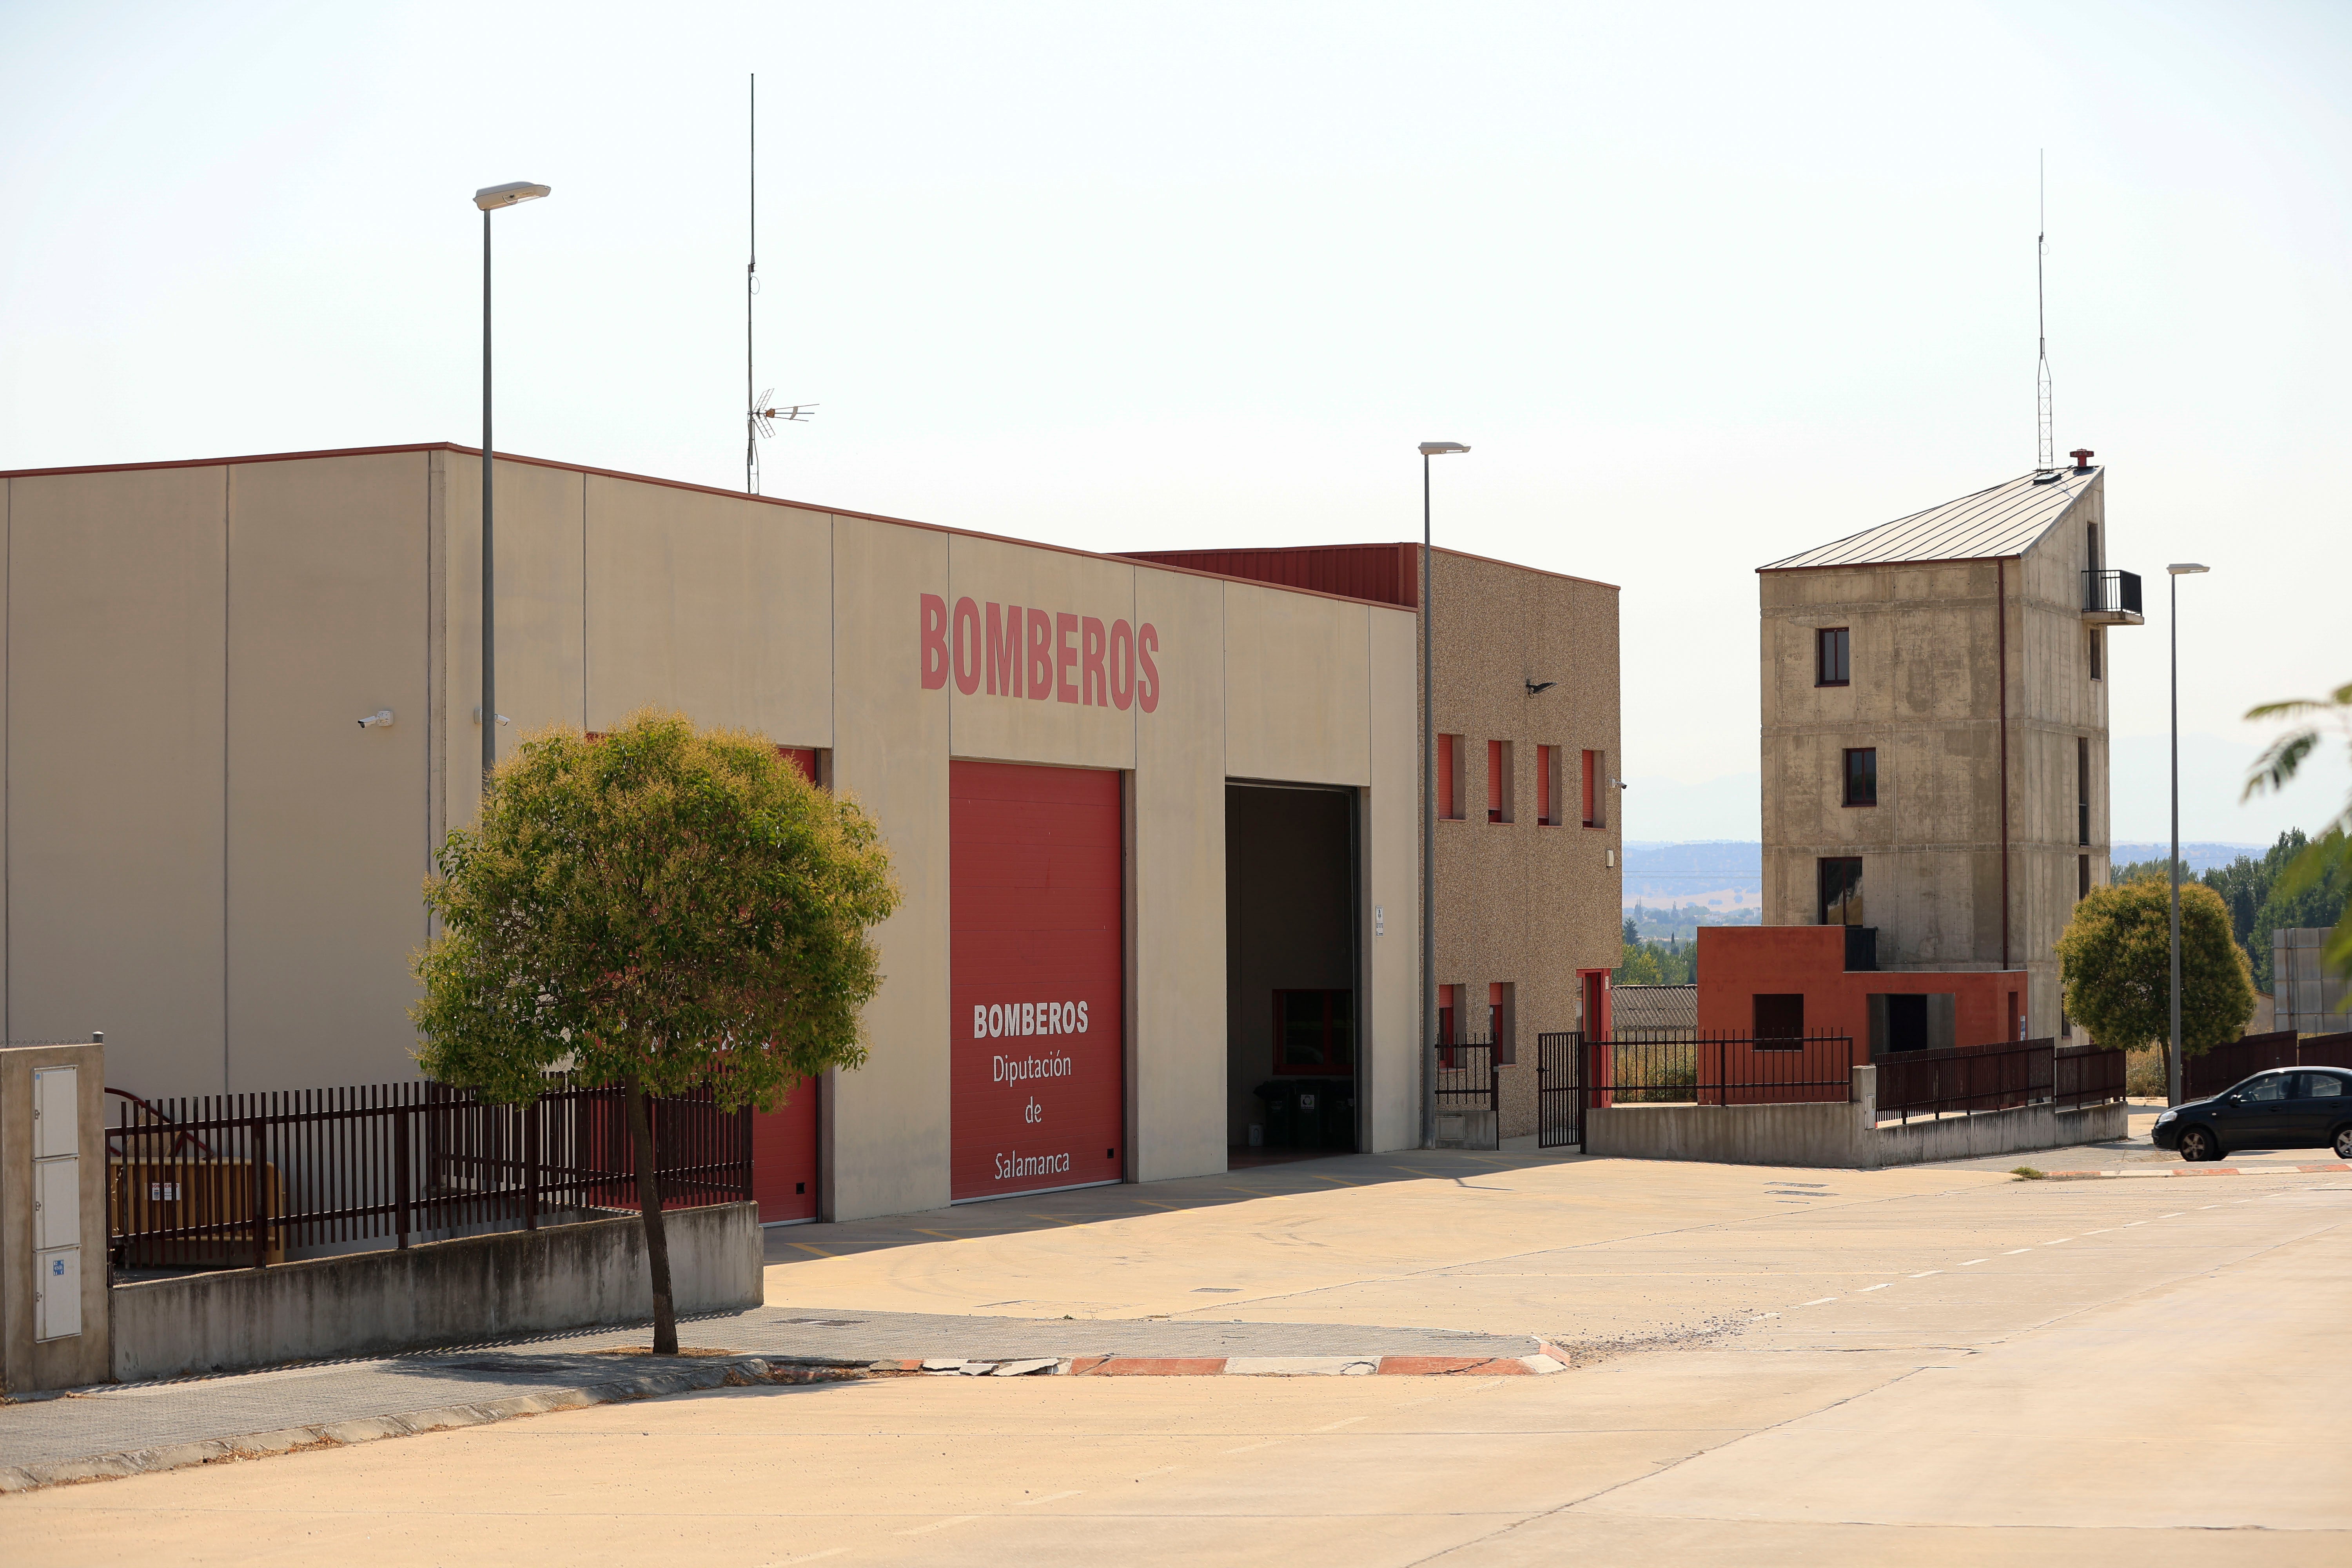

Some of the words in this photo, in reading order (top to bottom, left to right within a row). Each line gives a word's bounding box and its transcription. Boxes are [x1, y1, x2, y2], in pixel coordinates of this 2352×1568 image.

[920, 593, 1160, 713] BOMBEROS
[974, 1001, 1089, 1038] BOMBEROS
[993, 1050, 1071, 1087] Diputación
[1025, 1096, 1042, 1123] de
[995, 1150, 1070, 1180] Salamanca
